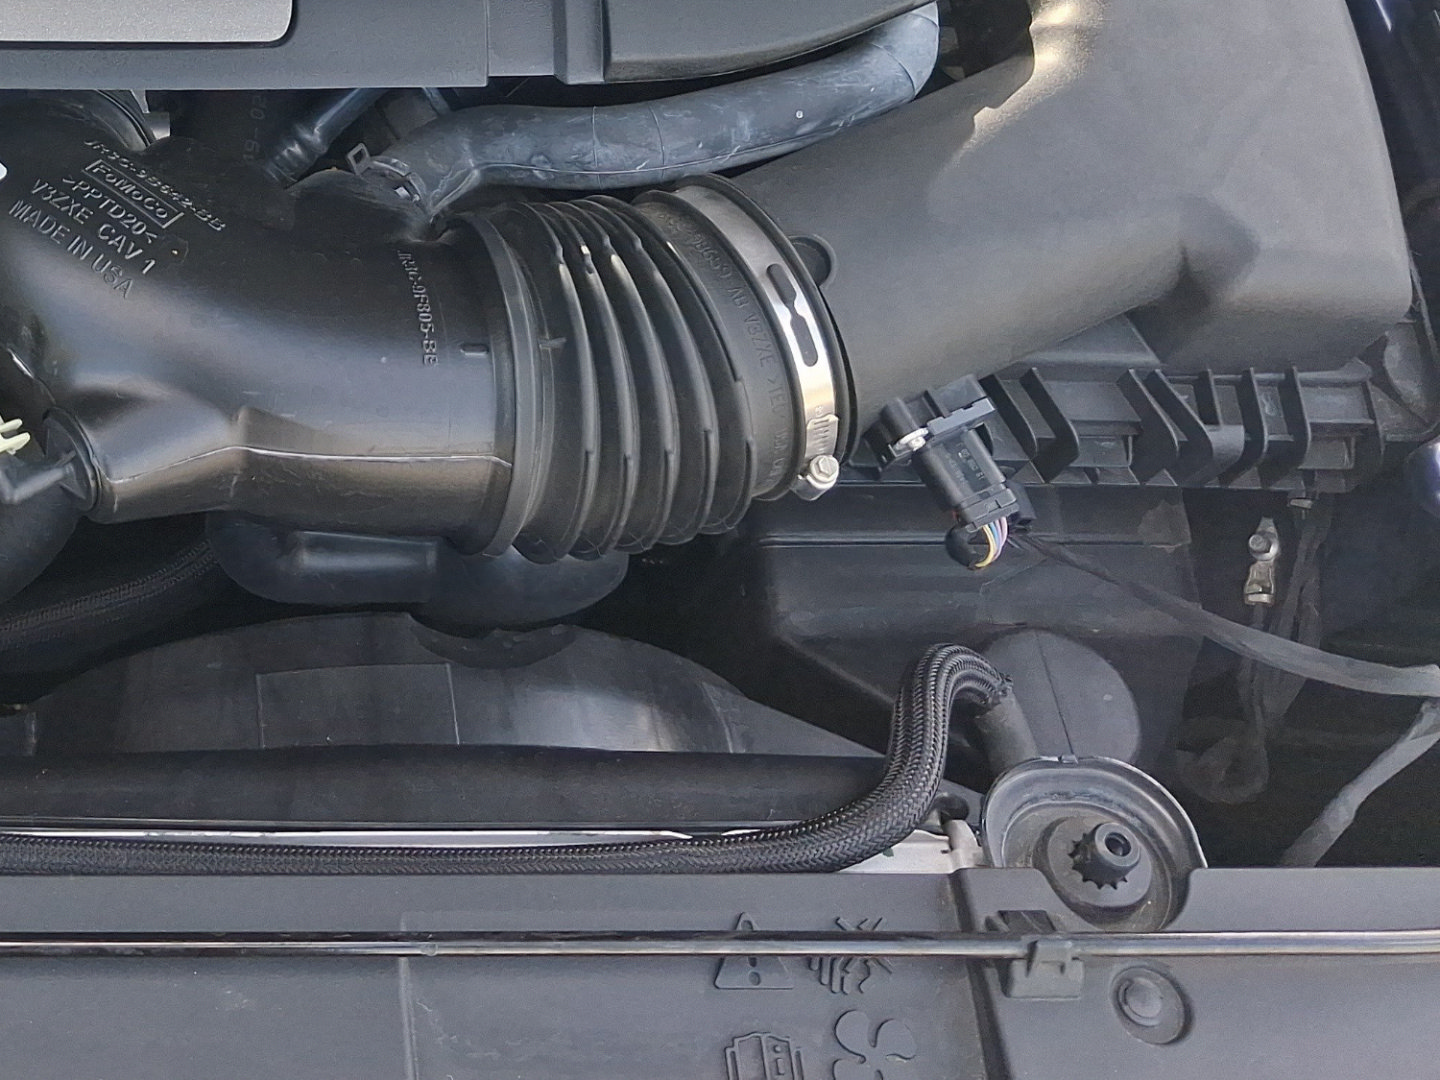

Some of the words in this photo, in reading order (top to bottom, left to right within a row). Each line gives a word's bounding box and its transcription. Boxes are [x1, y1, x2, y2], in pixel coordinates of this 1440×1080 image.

[30, 178, 94, 225] V3ZXE
[98, 223, 143, 260] CAV
[141, 258, 157, 275] 1
[92, 164, 169, 219] FoMoCo
[8, 199, 71, 245] MADE
[67, 234, 93, 261] IN
[91, 254, 135, 298] USA
